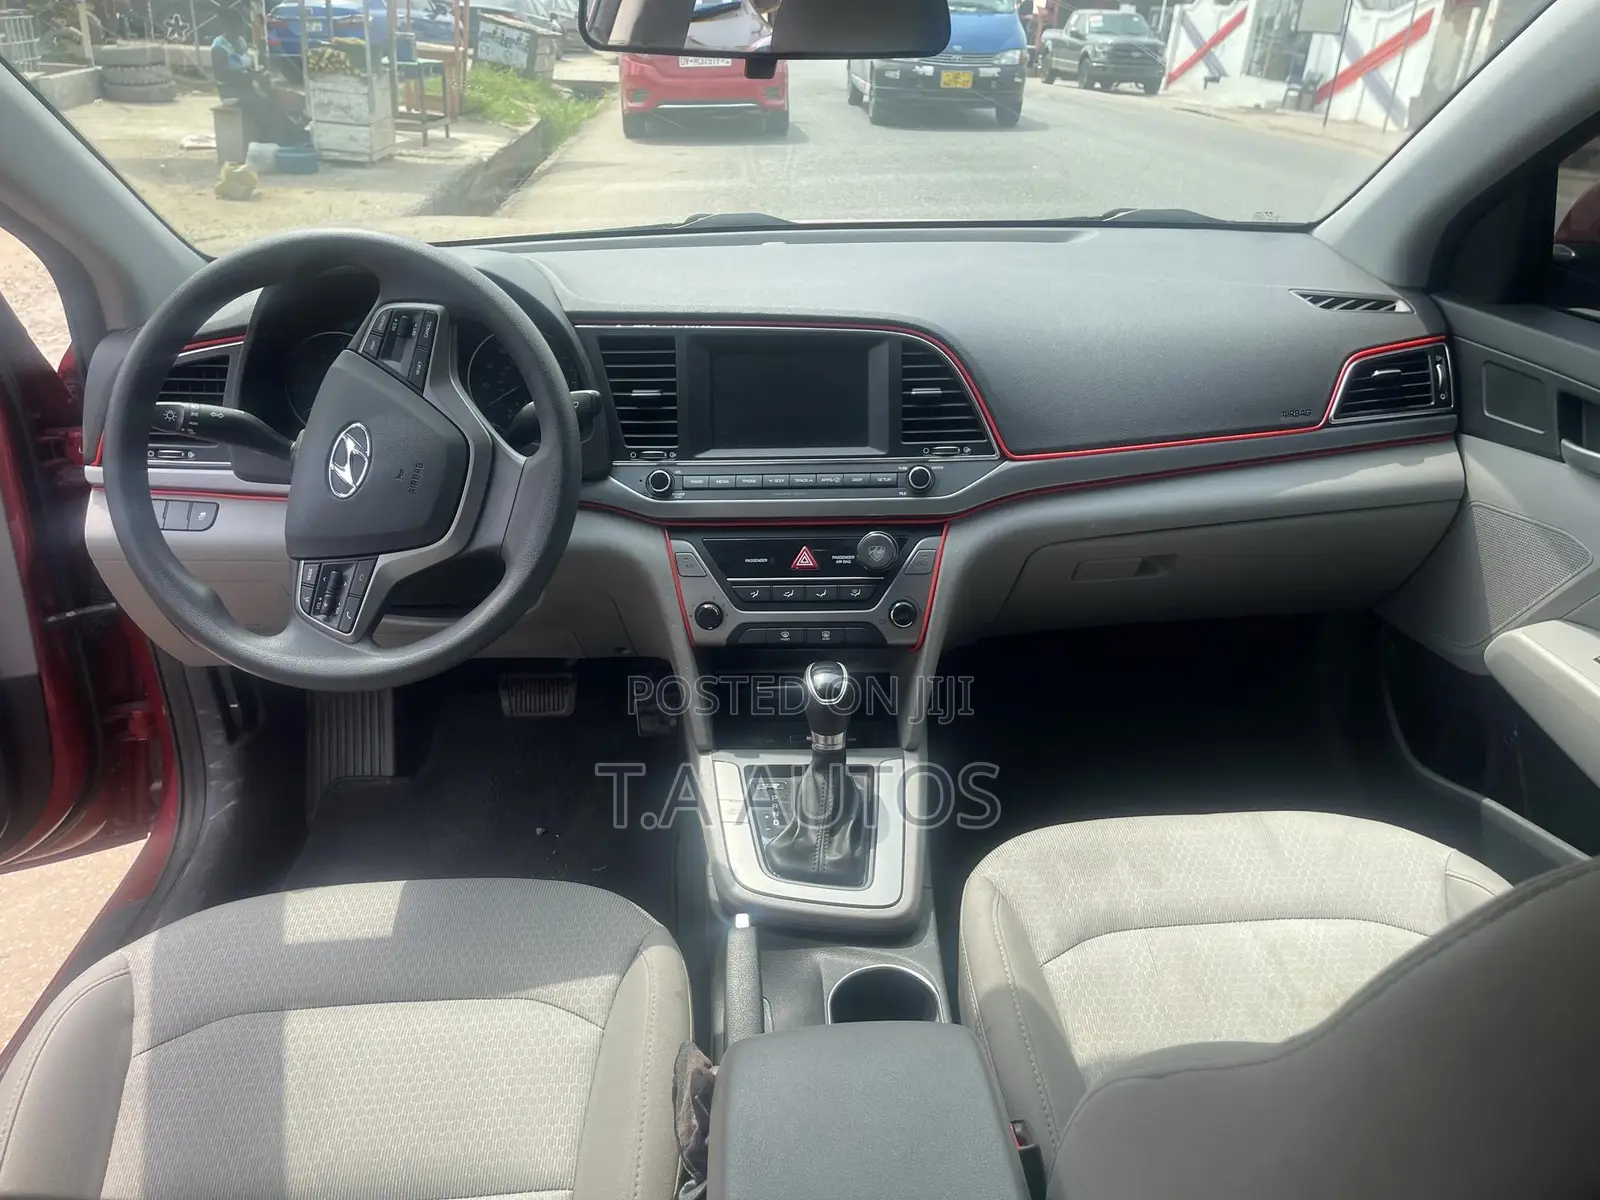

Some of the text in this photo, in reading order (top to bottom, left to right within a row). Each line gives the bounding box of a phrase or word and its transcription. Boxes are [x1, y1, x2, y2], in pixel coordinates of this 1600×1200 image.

[423, 321, 432, 339] CANCEL
[1281, 409, 1312, 418] AIRBAG
[407, 462, 424, 494] AIRBAG
